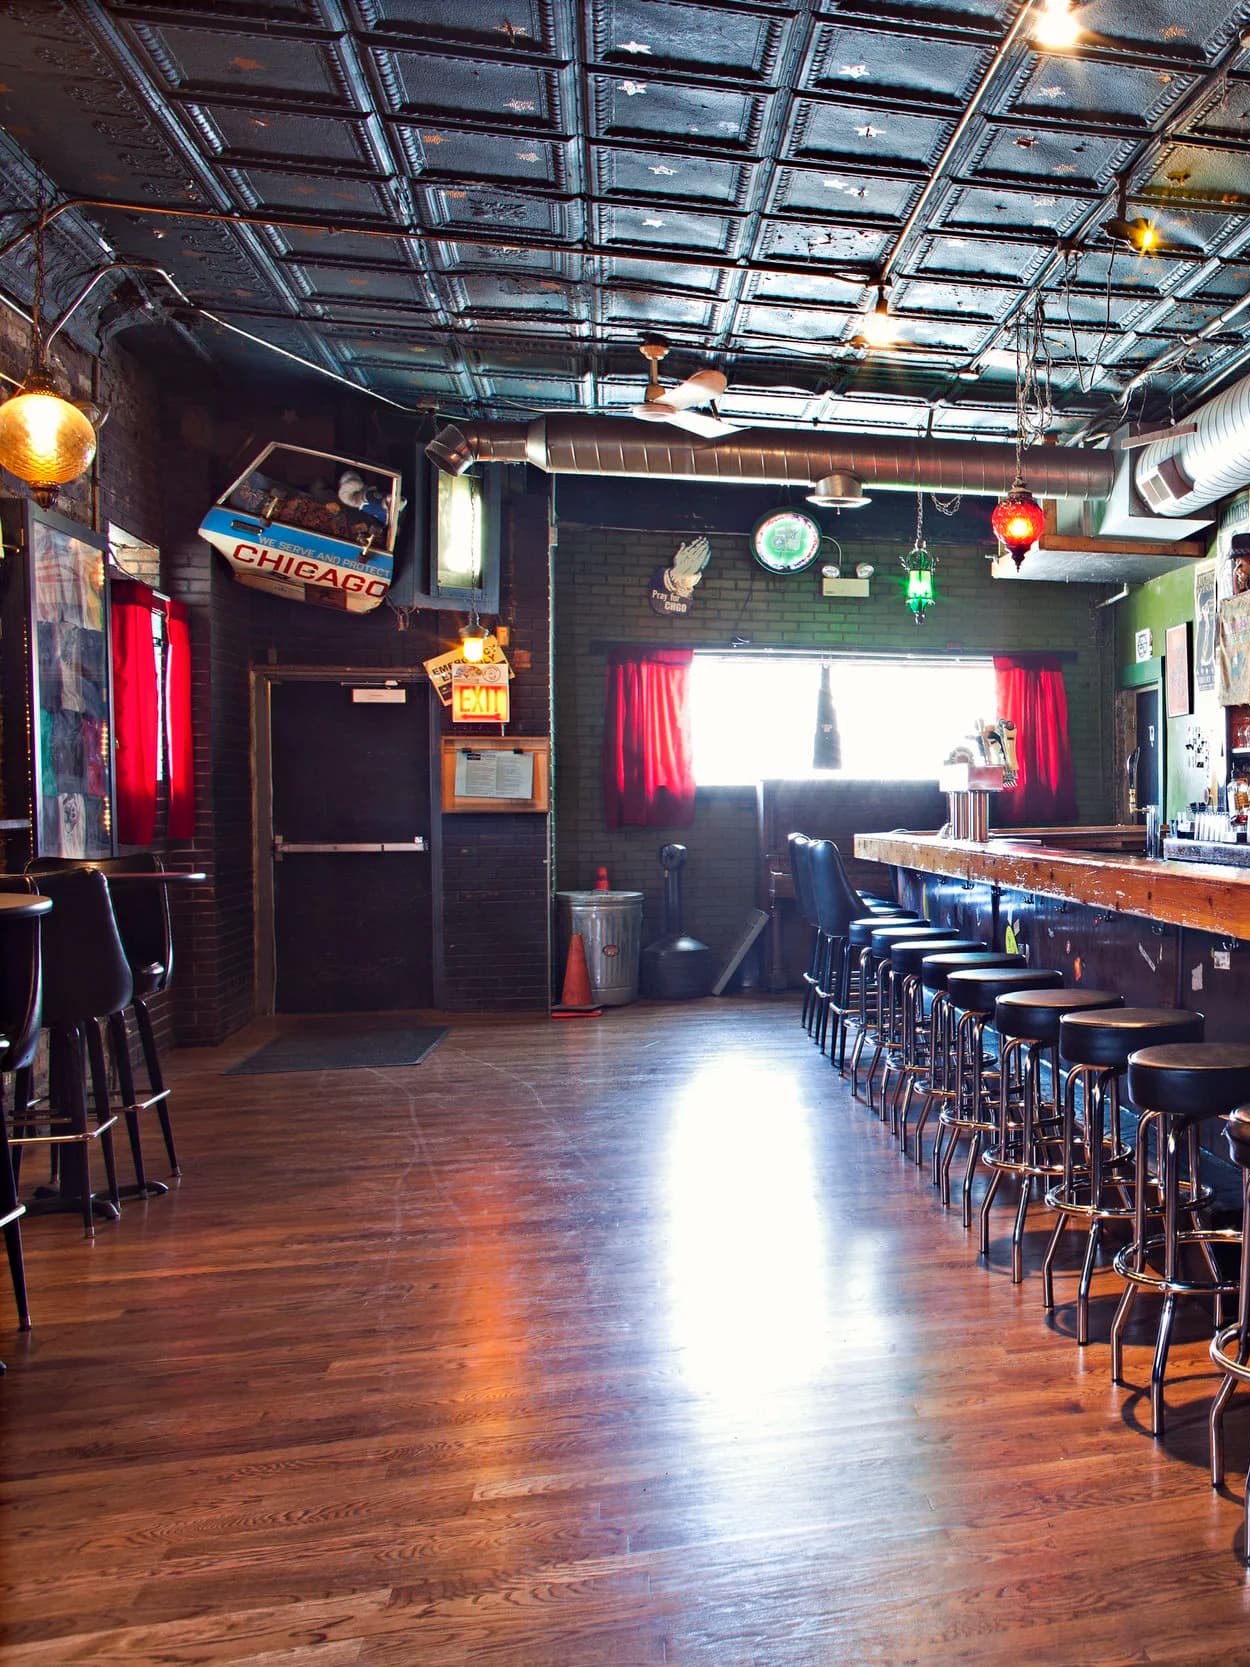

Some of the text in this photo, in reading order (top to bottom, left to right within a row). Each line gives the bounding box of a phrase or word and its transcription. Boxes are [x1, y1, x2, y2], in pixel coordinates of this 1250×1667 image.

[232, 543, 390, 599] CHICAGO
[258, 535, 391, 578] WE SERVE AND PROTECT
[652, 589, 667, 602] Pray
[460, 686, 502, 713] EXIT
